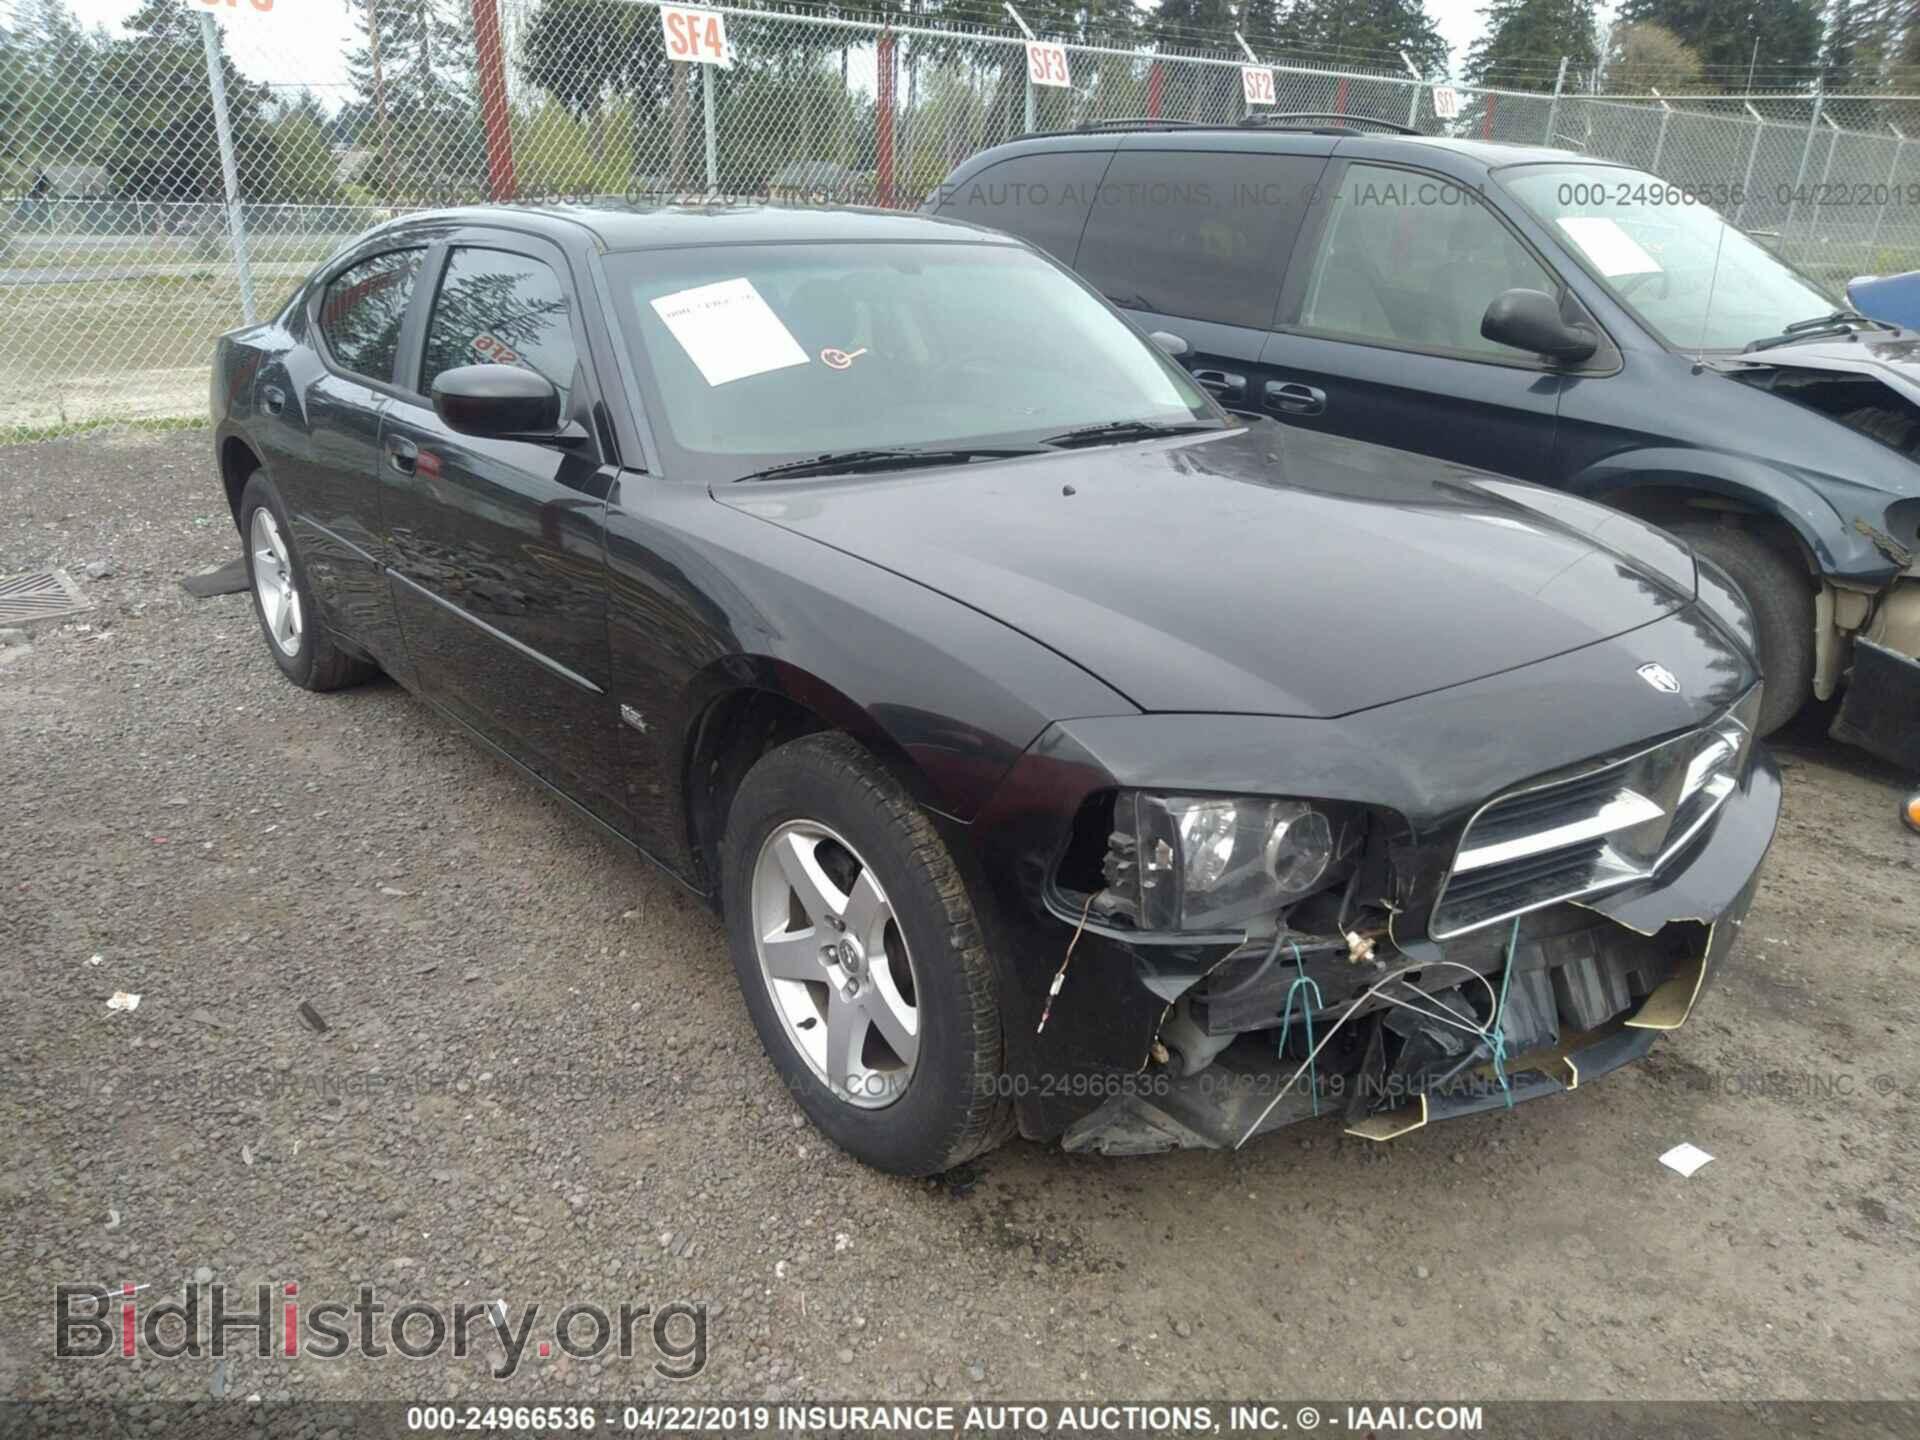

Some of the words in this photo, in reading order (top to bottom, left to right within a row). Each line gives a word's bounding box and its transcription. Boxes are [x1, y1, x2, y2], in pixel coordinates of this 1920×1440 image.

[667, 12, 722, 57] SF4
[1030, 46, 1066, 81] SF3
[1246, 71, 1272, 99] SF2
